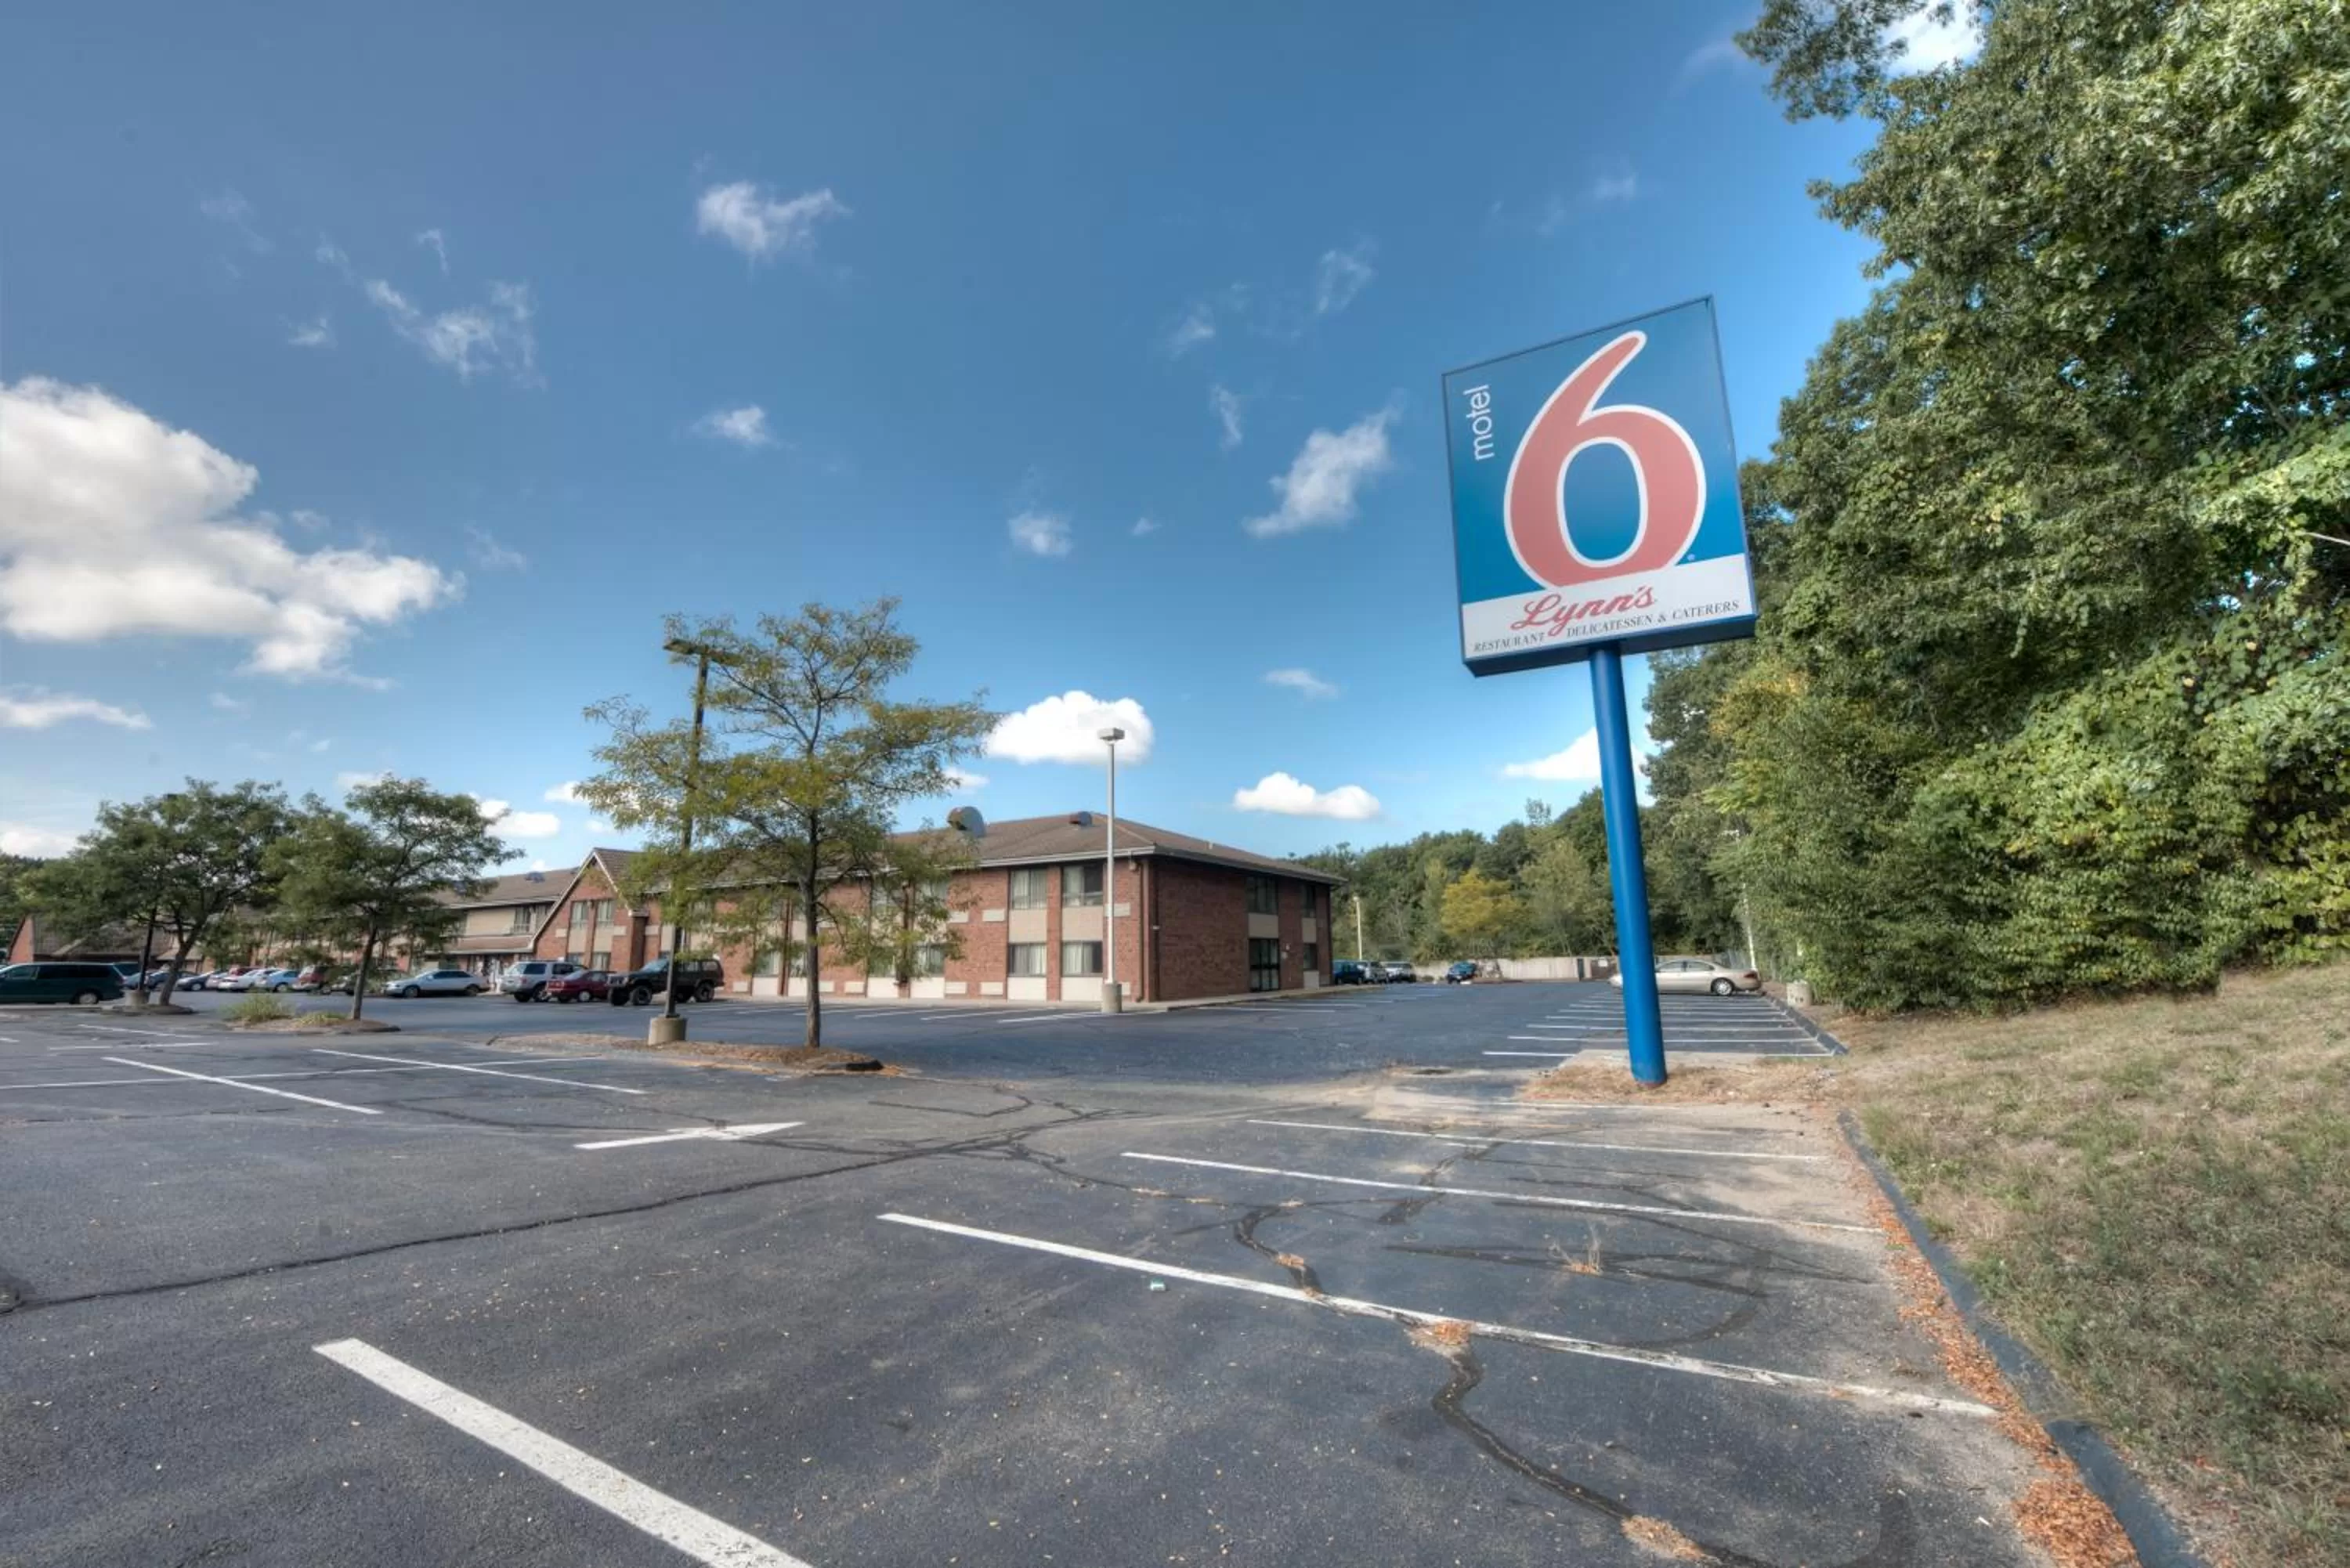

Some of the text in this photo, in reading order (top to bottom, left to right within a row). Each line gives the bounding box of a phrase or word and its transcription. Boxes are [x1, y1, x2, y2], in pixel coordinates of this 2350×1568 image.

[1463, 384, 1495, 461] motel
[1504, 330, 1706, 588] 6
[1473, 600, 1740, 652] RESTAURANT DELICATESSEN & CATERERS
[1510, 585, 1656, 637] Lynn's
